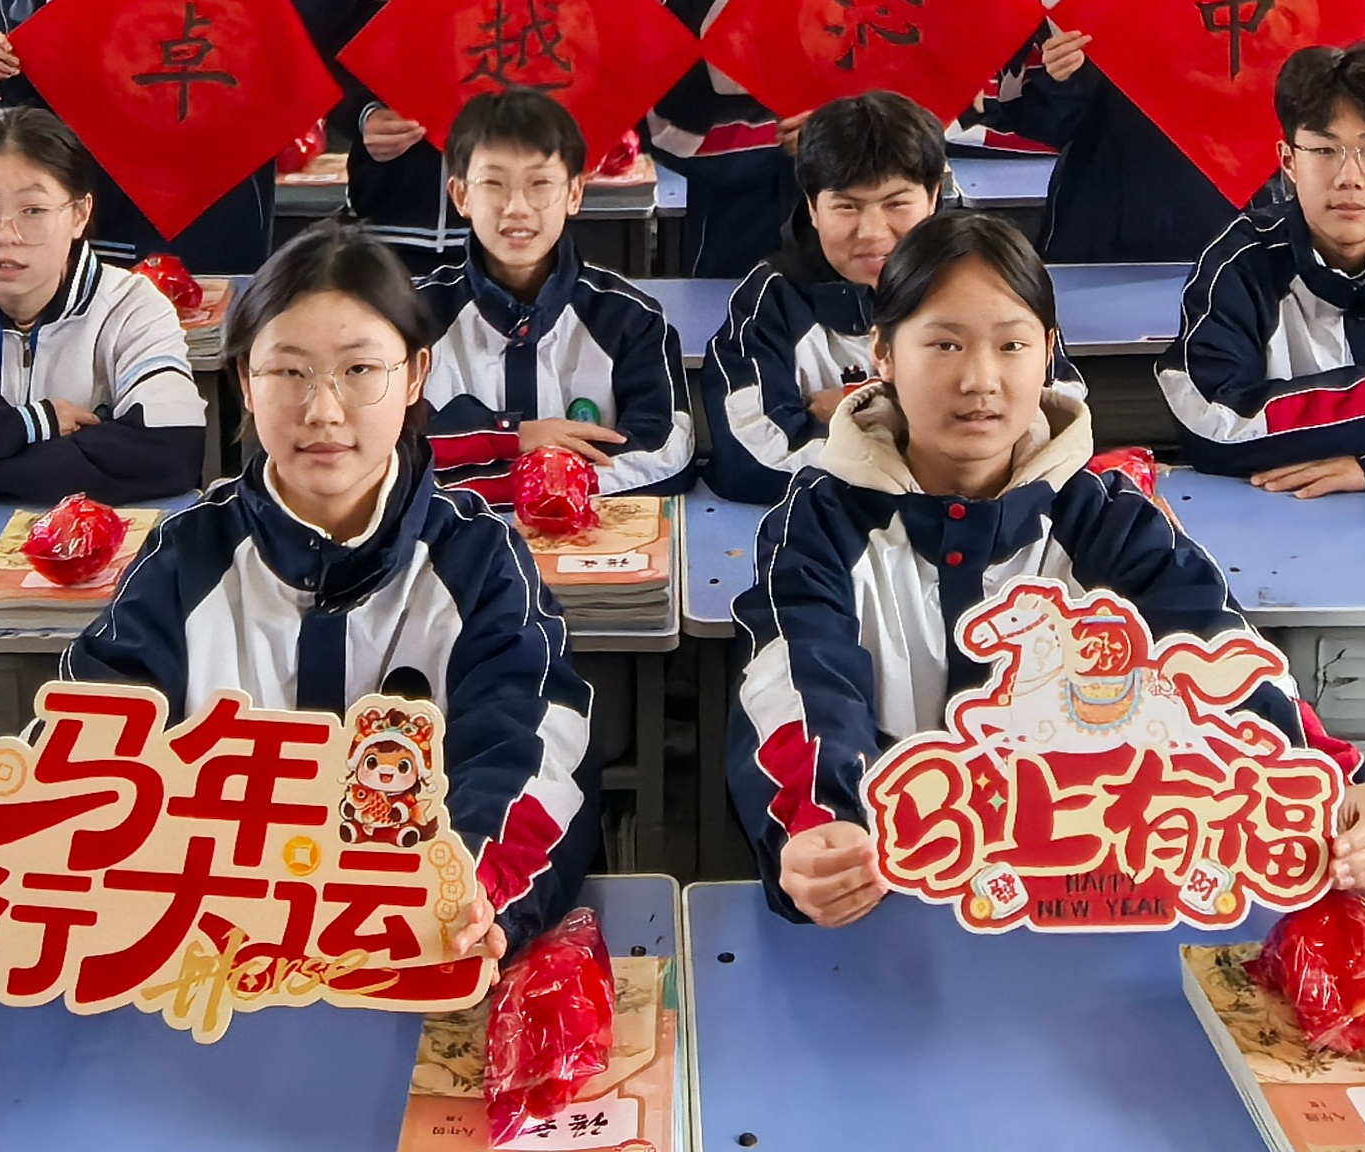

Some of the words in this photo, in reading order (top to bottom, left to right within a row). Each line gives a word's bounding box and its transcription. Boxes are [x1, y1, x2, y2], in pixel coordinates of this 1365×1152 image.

[131, 1, 238, 122] 卓
[884, 751, 1324, 879] 马上有福
[1037, 899, 1090, 919] NEW
[1107, 898, 1169, 918] YEAR
[141, 927, 400, 1033] Horse
